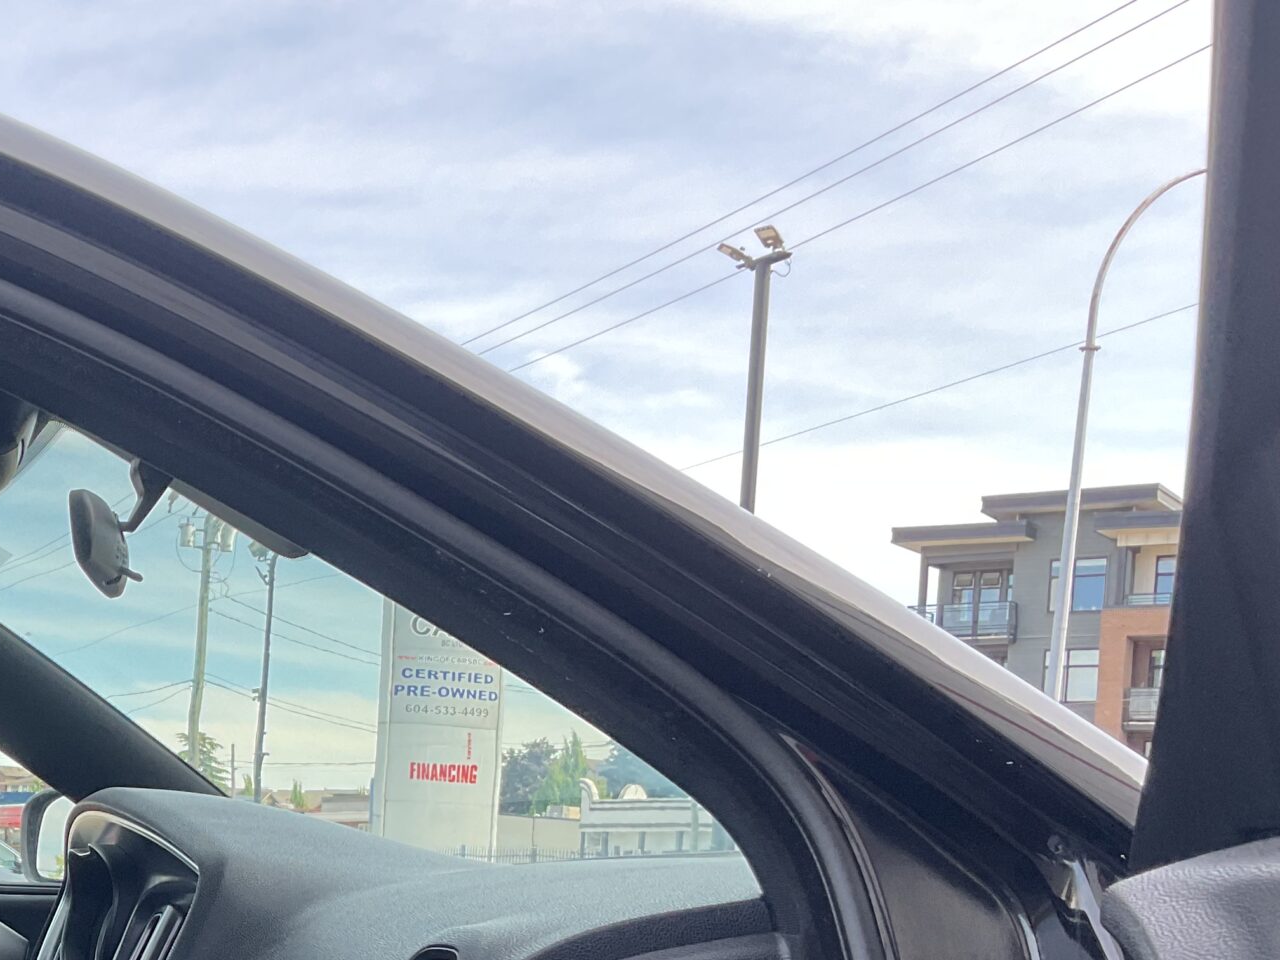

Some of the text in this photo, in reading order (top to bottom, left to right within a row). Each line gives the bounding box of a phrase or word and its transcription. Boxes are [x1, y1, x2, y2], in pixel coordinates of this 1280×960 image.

[401, 667, 494, 684] CERTIFIED
[393, 684, 498, 702] PRE-OWNED
[405, 703, 489, 718] 604-533-4499
[409, 762, 478, 785] FINANCING
